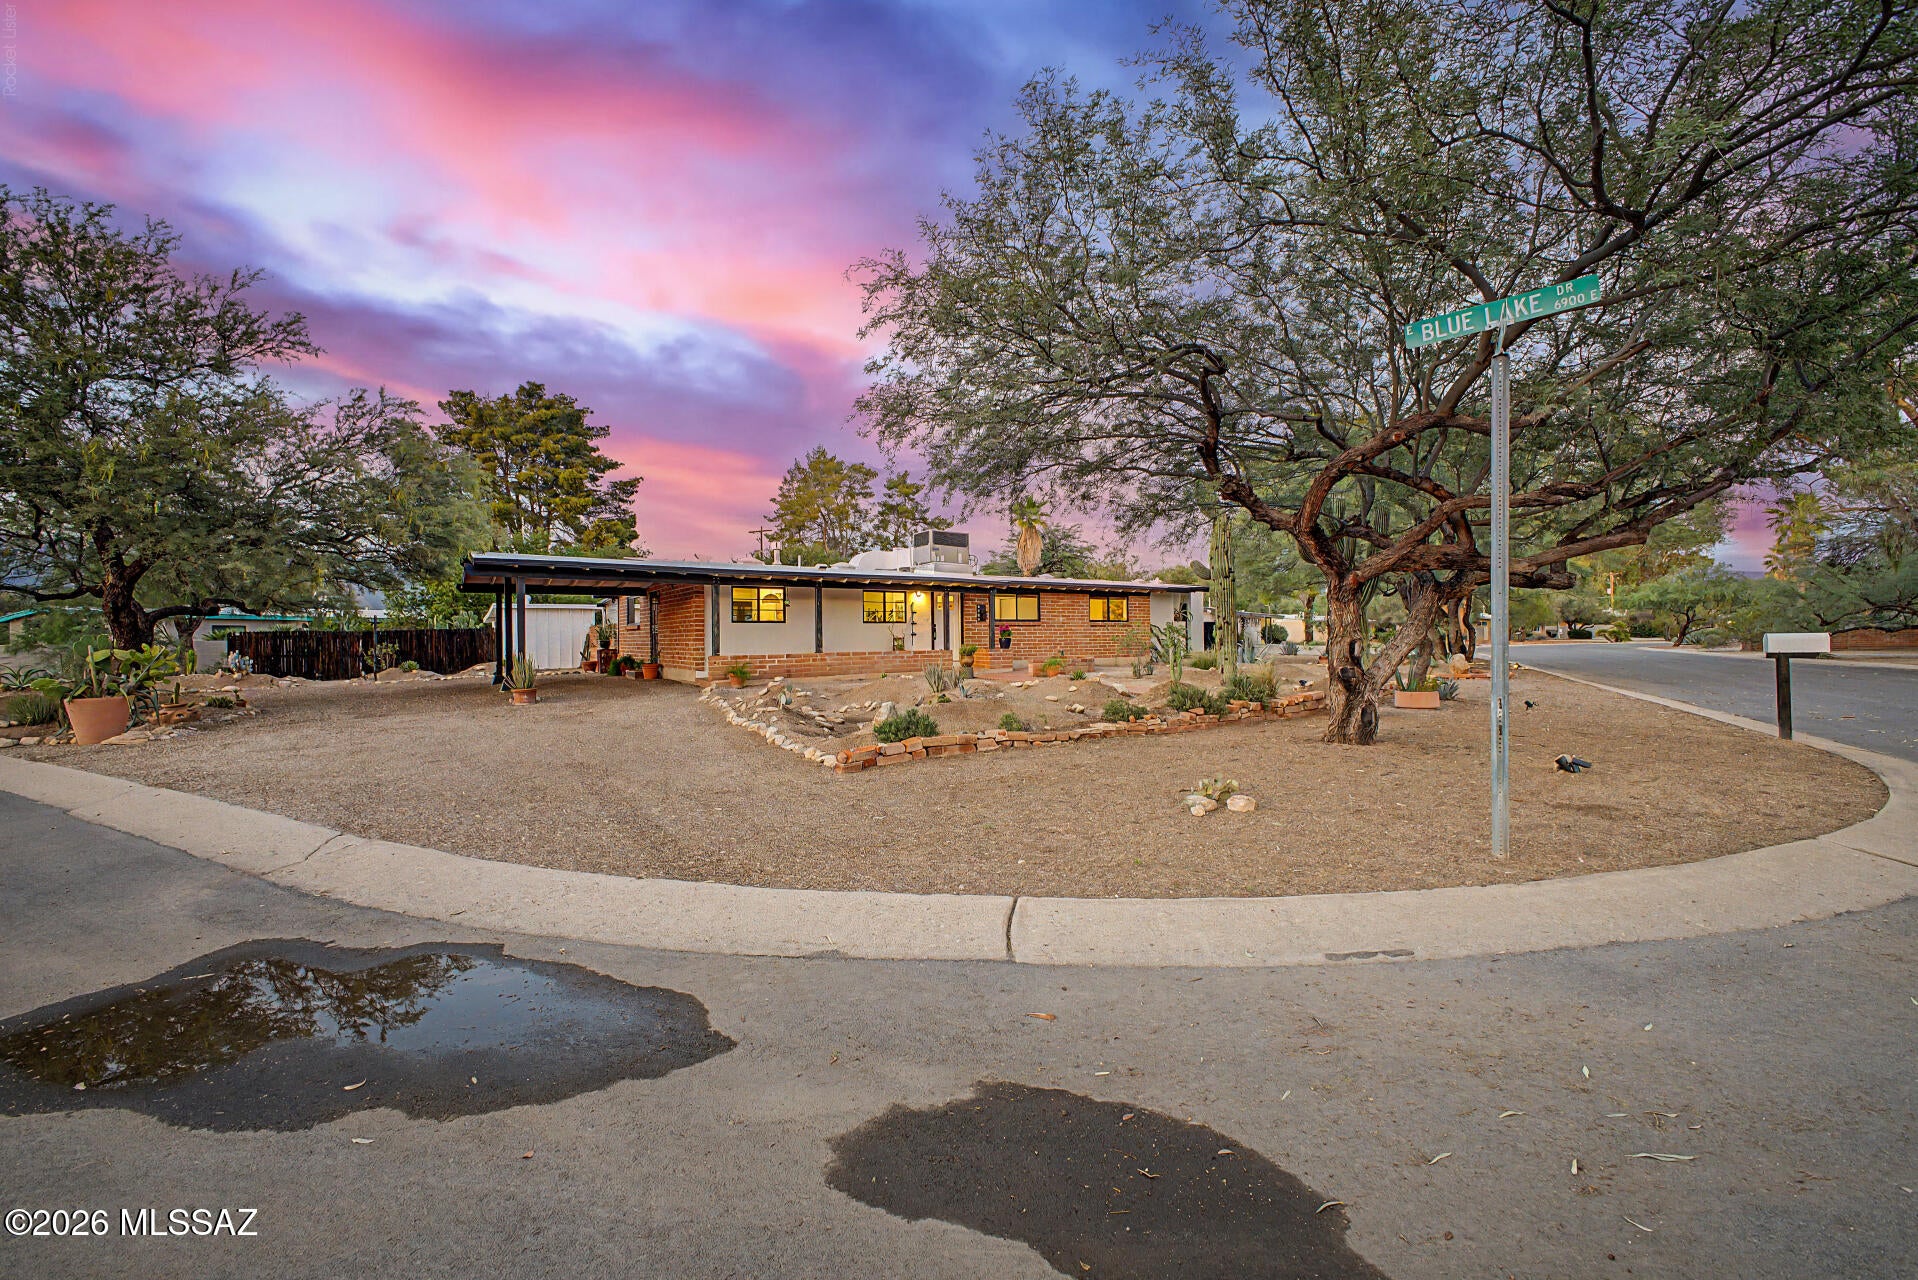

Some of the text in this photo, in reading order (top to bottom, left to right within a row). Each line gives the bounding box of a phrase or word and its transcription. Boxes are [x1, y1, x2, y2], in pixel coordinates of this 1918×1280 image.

[1406, 282, 1574, 342] E BLUE LAKE DR
[1553, 289, 1599, 310] 6900 E
